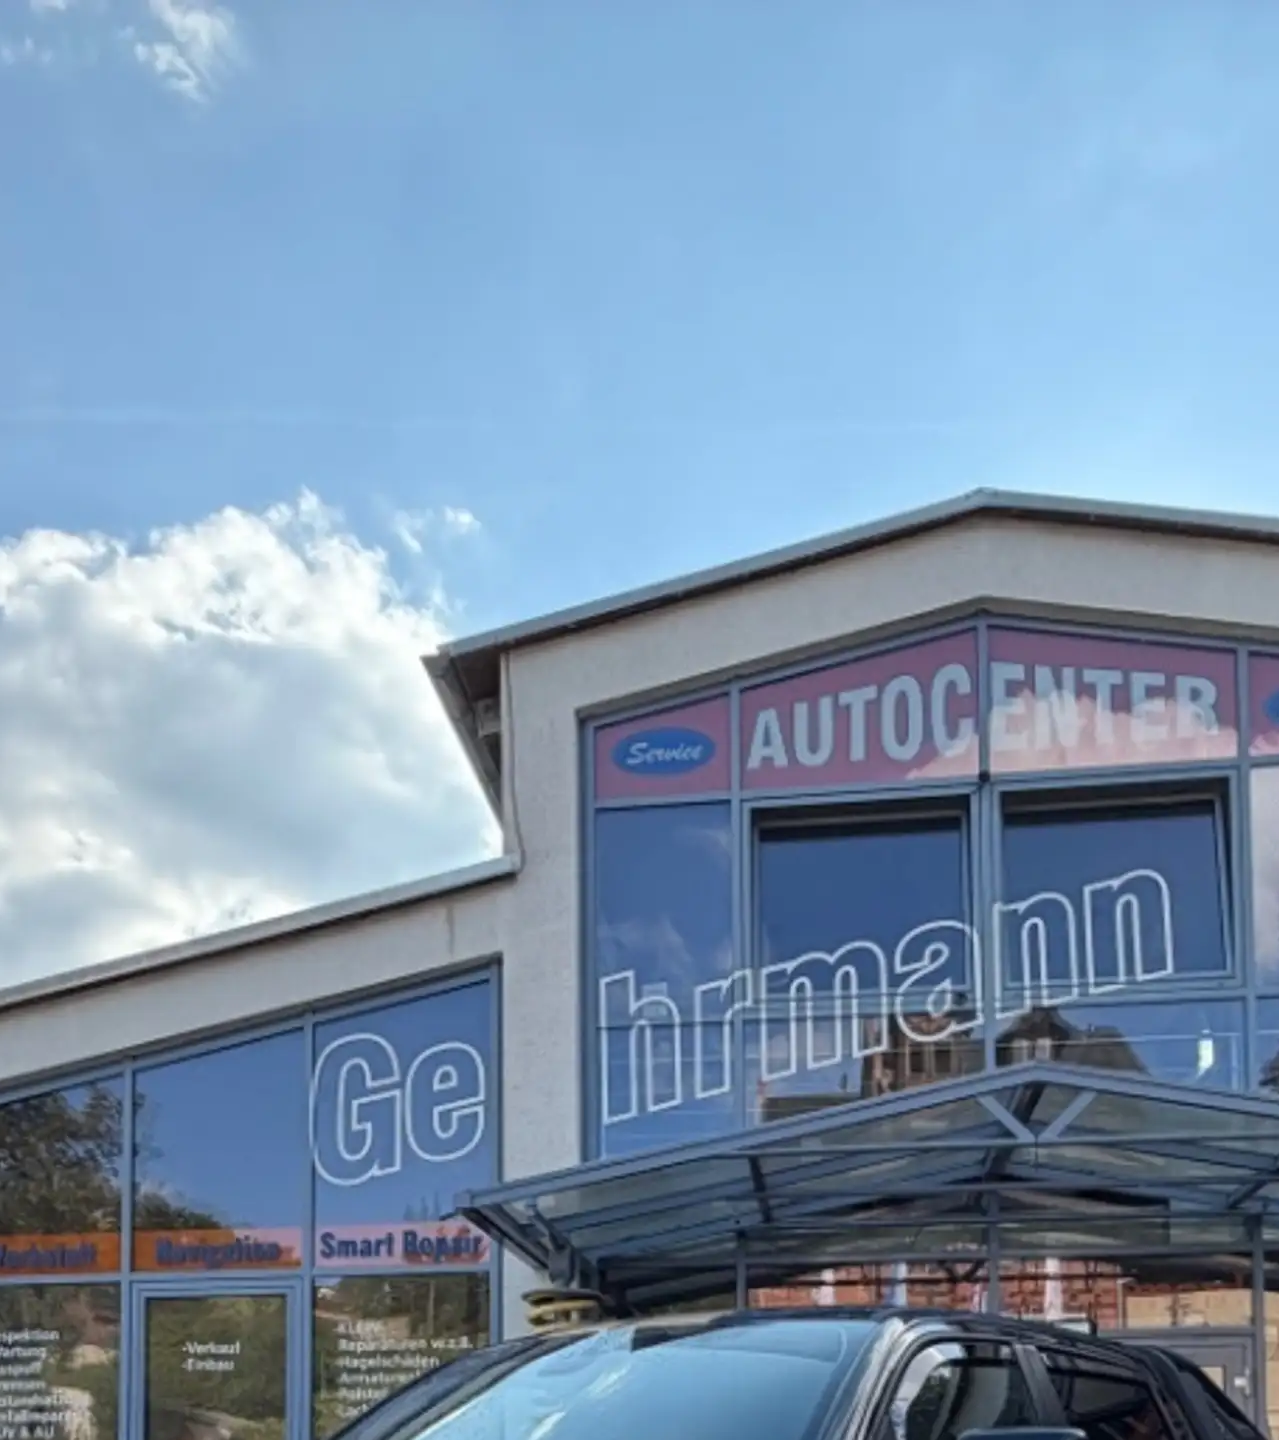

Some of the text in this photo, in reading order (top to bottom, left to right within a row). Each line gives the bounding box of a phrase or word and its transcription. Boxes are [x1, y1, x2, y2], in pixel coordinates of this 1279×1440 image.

[746, 660, 1221, 770] AUTOCENTER
[624, 740, 706, 766] Service
[320, 1229, 484, 1264] Smart Repair
